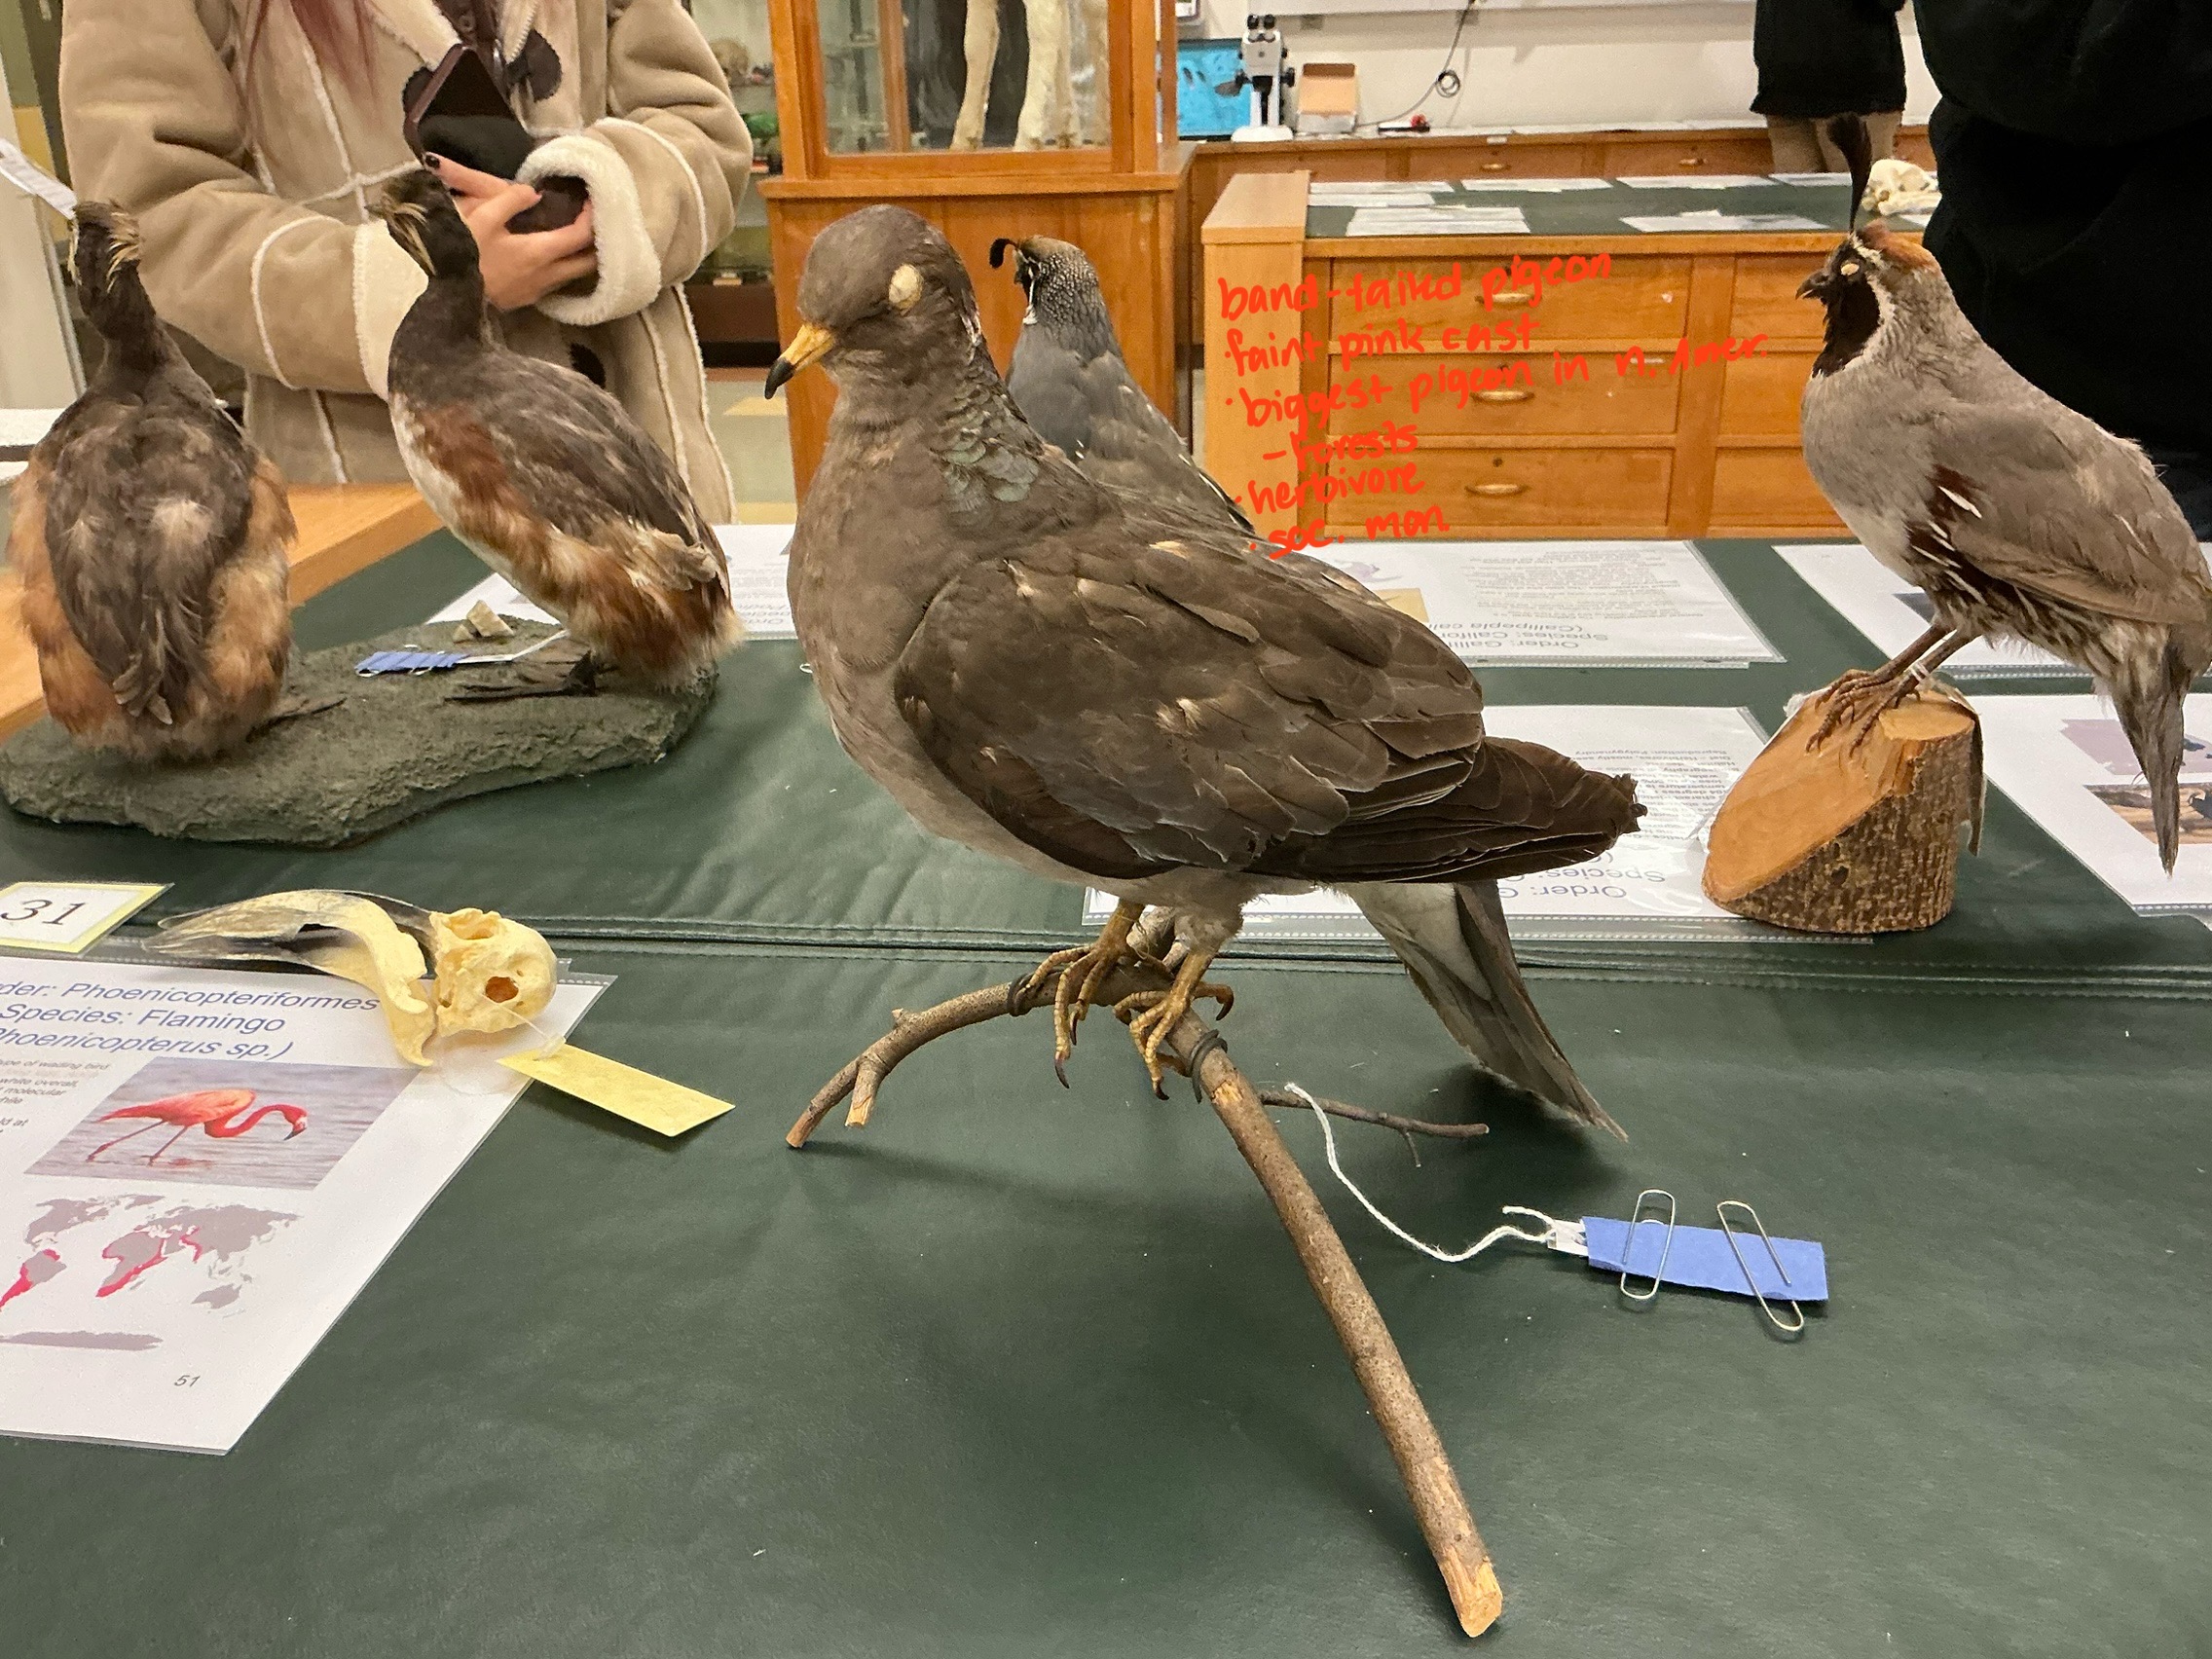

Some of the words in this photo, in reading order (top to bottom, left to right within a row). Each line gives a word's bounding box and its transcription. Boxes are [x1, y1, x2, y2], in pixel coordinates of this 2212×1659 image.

[1538, 867, 1666, 883] Species:
[1530, 885, 1626, 898] Order:
[0, 898, 88, 927] 31
[0, 980, 56, 997] der:
[60, 981, 381, 1011] Phoenicopteriformes
[0, 1003, 132, 1025] Species:
[136, 1009, 286, 1035] Flamingo
[225, 1041, 294, 1061] sp.)
[173, 1374, 202, 1387] 51
